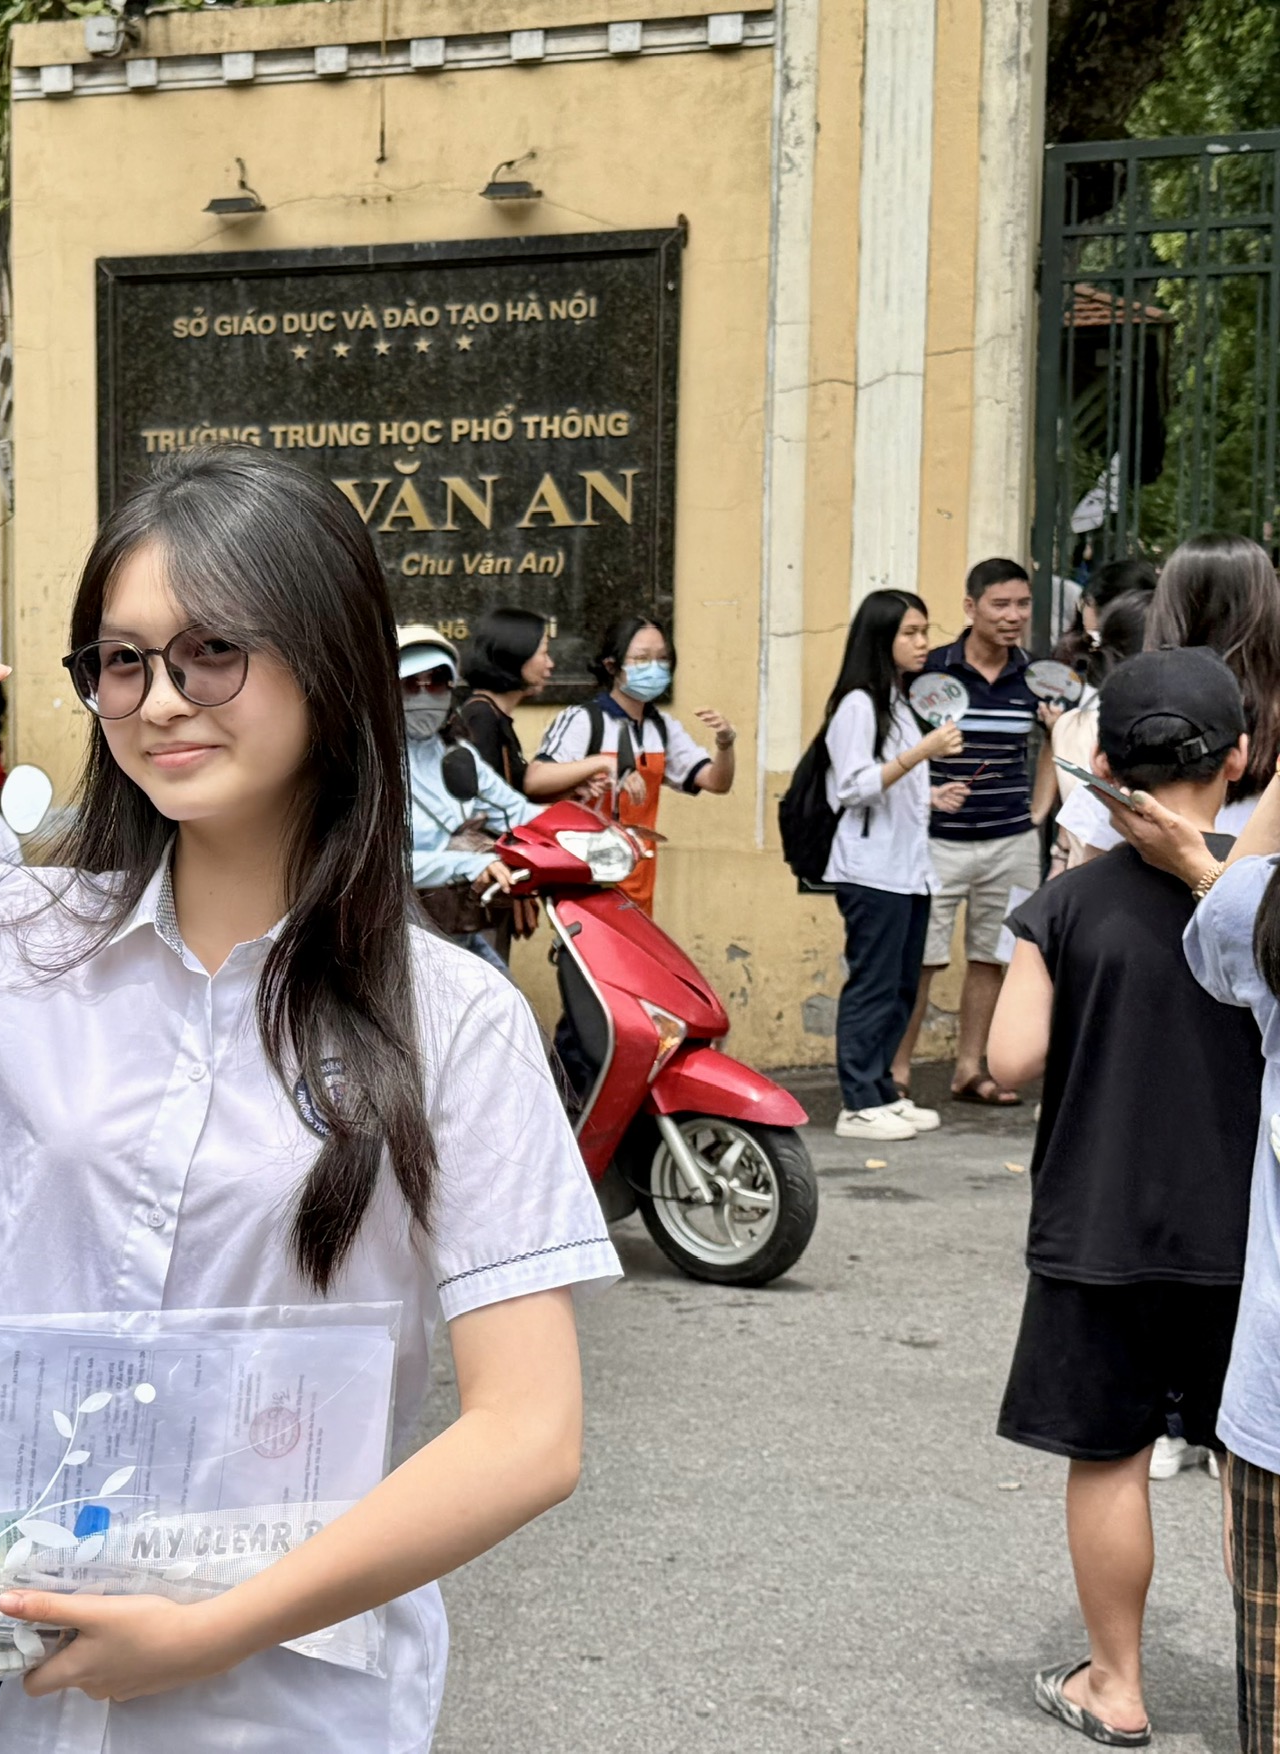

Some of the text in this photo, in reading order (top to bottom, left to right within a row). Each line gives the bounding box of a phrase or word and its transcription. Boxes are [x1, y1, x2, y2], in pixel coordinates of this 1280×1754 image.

[173, 290, 598, 339] SỞ GIÁO DỤC VÀ ĐÀO TẠO HÀ NỘI
[269, 422, 371, 449] TRUNG
[378, 420, 443, 452] HỌC
[450, 402, 516, 443] PHỔ
[521, 407, 630, 440] THÔNG
[330, 459, 642, 532] VĂN AN
[400, 551, 566, 579] Chu Văn An)
[131, 1526, 187, 1560] MY
[192, 1520, 294, 1557] CLEAR
